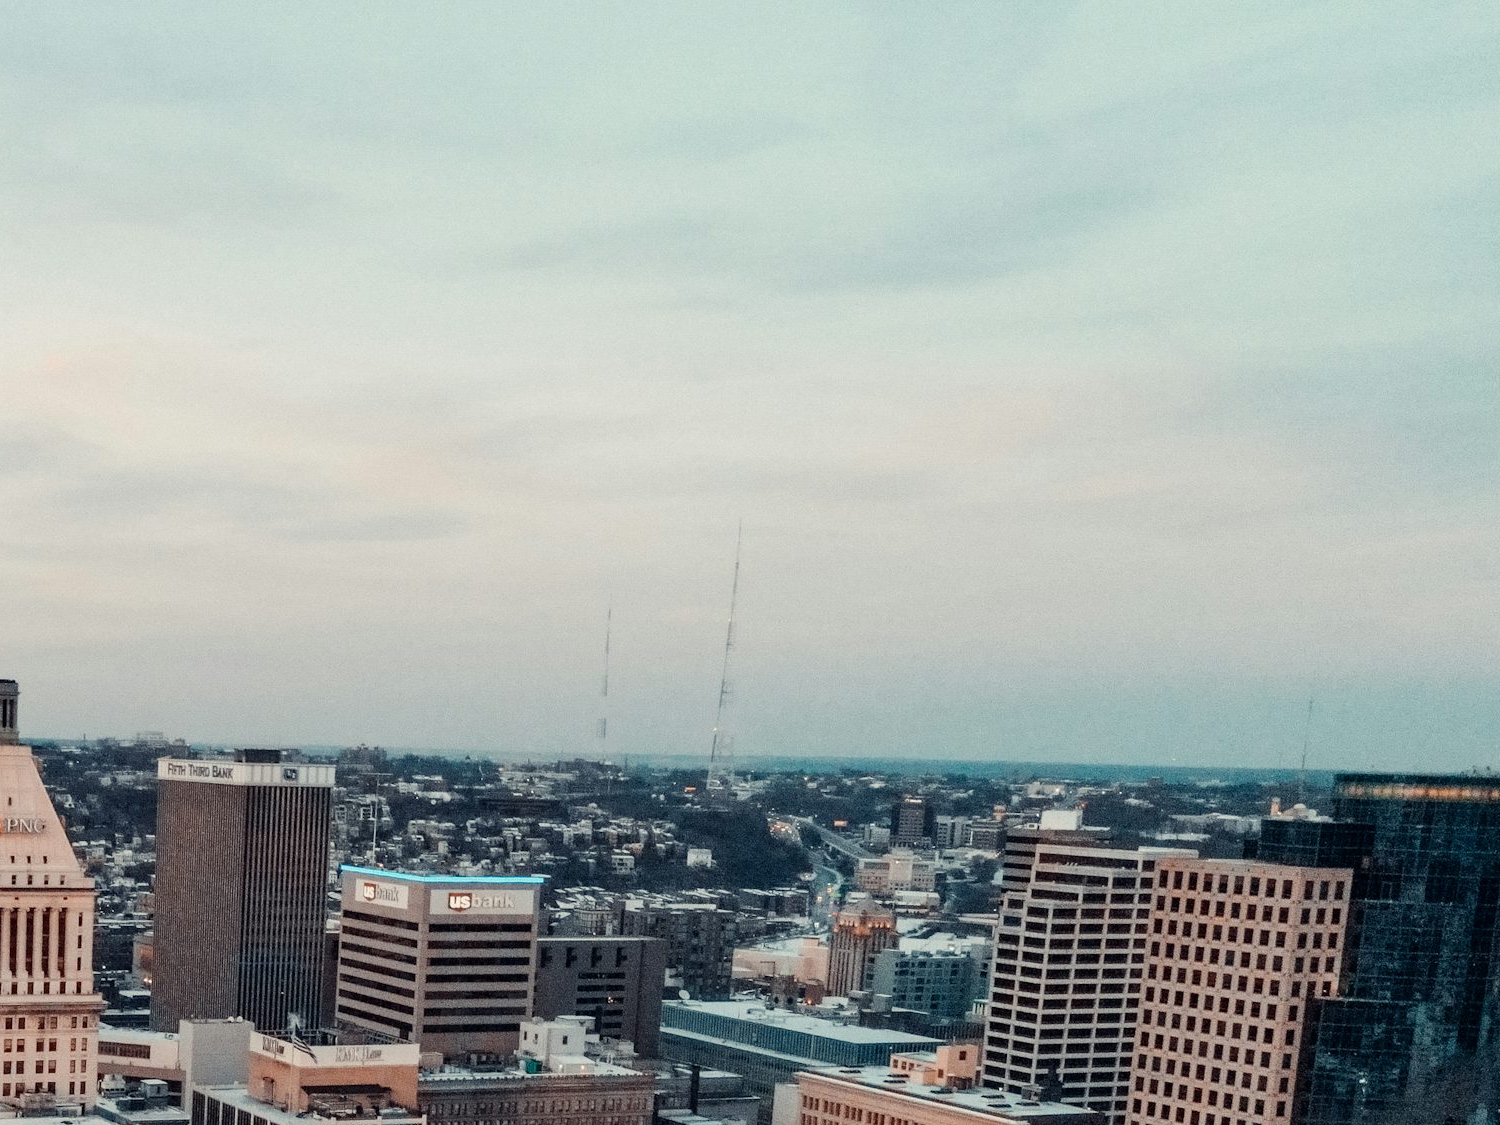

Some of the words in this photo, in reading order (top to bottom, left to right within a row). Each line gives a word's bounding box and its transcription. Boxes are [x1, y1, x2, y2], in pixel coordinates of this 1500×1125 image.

[167, 763, 186, 777] FIFTH
[188, 763, 210, 778] THIRD
[212, 765, 234, 780] BANK
